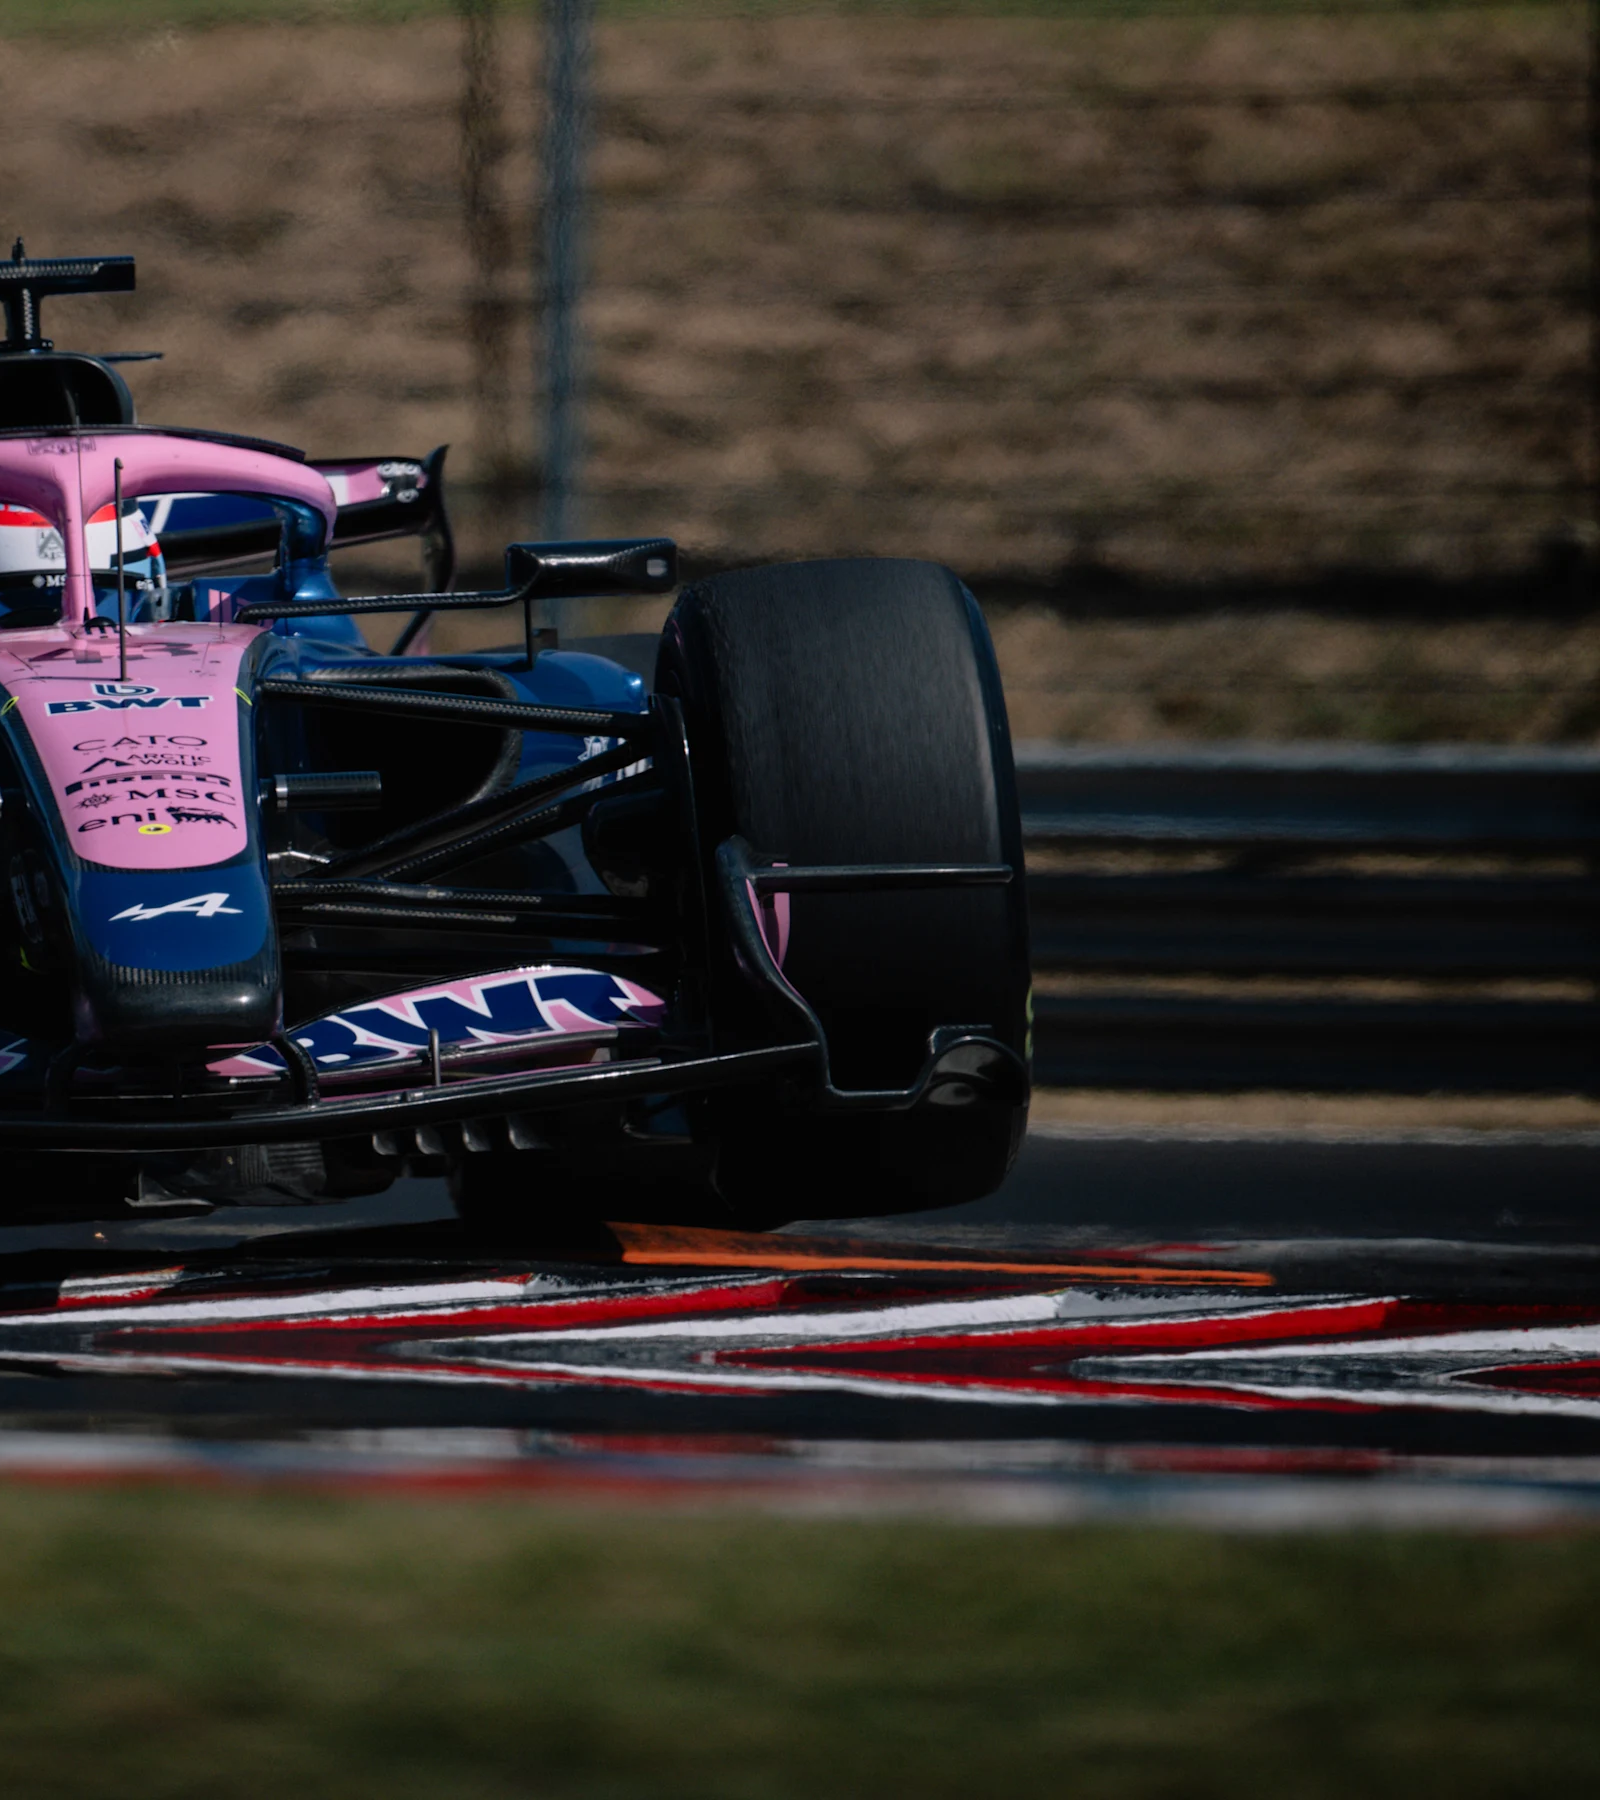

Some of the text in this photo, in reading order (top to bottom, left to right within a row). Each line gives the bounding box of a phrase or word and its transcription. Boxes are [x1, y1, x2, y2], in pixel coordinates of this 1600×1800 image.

[46, 574, 68, 588] MS
[46, 696, 211, 716] BWT
[73, 735, 208, 751] CATO
[127, 753, 212, 763] ARCTIC
[139, 759, 206, 767] WOLF
[126, 788, 237, 806] MSC
[78, 808, 158, 833] eni
